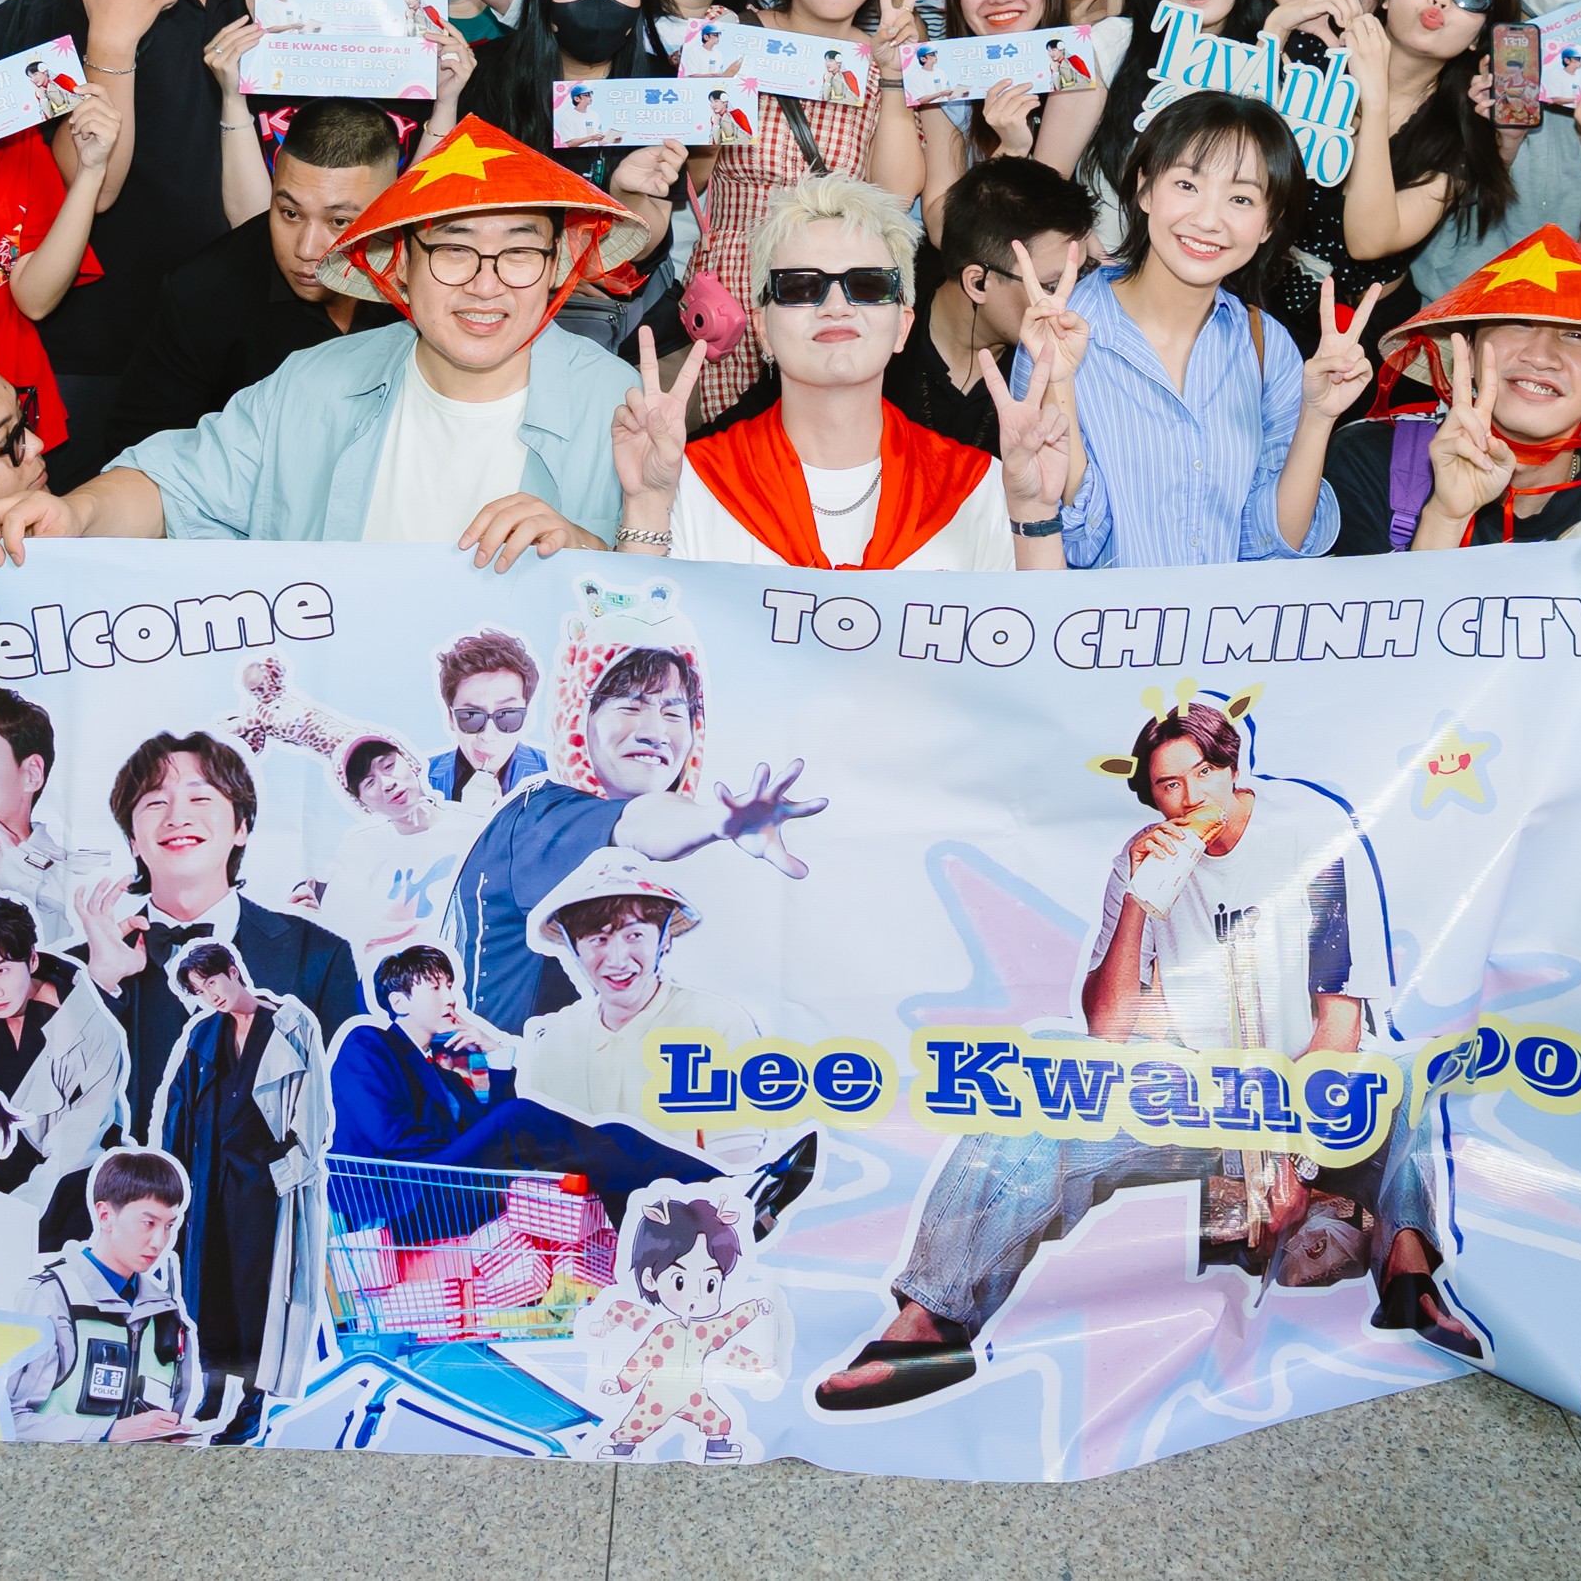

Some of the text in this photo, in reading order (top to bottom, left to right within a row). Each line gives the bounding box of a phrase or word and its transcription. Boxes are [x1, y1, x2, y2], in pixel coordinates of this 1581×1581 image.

[269, 41, 289, 50] LEE
[292, 42, 338, 52] KWANG
[341, 43, 366, 53] SOO
[370, 45, 401, 55] OPPA
[731, 32, 813, 59] 우리 광수가
[951, 40, 1033, 61] 우리 광수가
[271, 54, 408, 70] WELCOME BACK
[754, 55, 809, 77] 왔어요!
[959, 60, 1033, 81] 또 왔어요!
[286, 74, 391, 89] TO VIETNAM
[607, 88, 694, 105] 우리 광수가
[613, 107, 693, 125] 또 왔어요!
[763, 589, 881, 651] TO
[898, 603, 1035, 668] HO
[1054, 608, 1186, 669] CHI
[1202, 600, 1422, 665] MINH
[659, 1040, 1388, 1150] Lee Kwang
[95, 1368, 123, 1386] 경찰
[93, 1386, 119, 1396] POLICE
